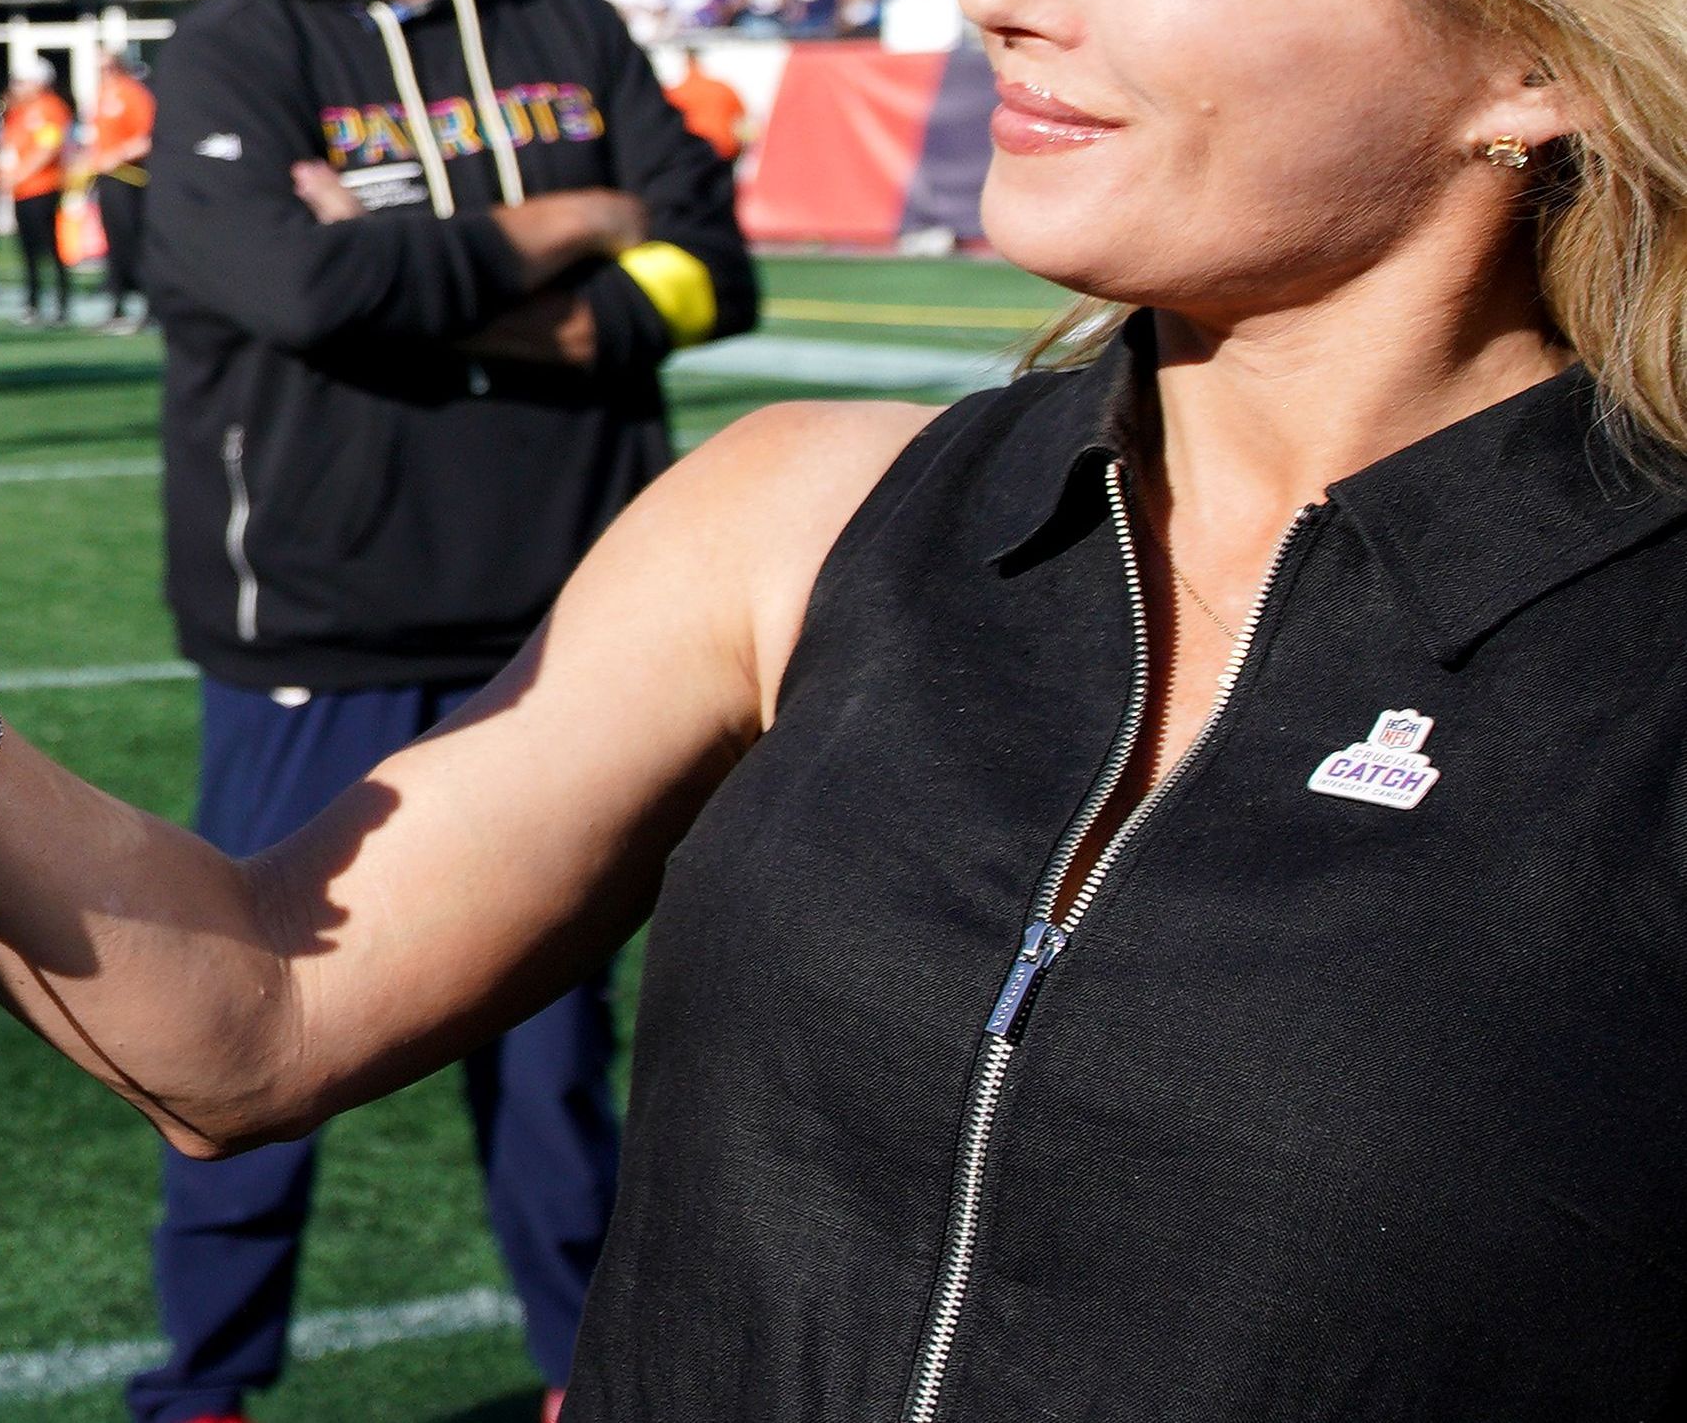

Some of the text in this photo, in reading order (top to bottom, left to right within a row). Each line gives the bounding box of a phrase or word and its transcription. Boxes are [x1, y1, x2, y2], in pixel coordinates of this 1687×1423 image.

[1382, 730, 1413, 745] NFL
[1352, 749, 1418, 769] CRUCIAL
[1328, 758, 1428, 792] CATCH
